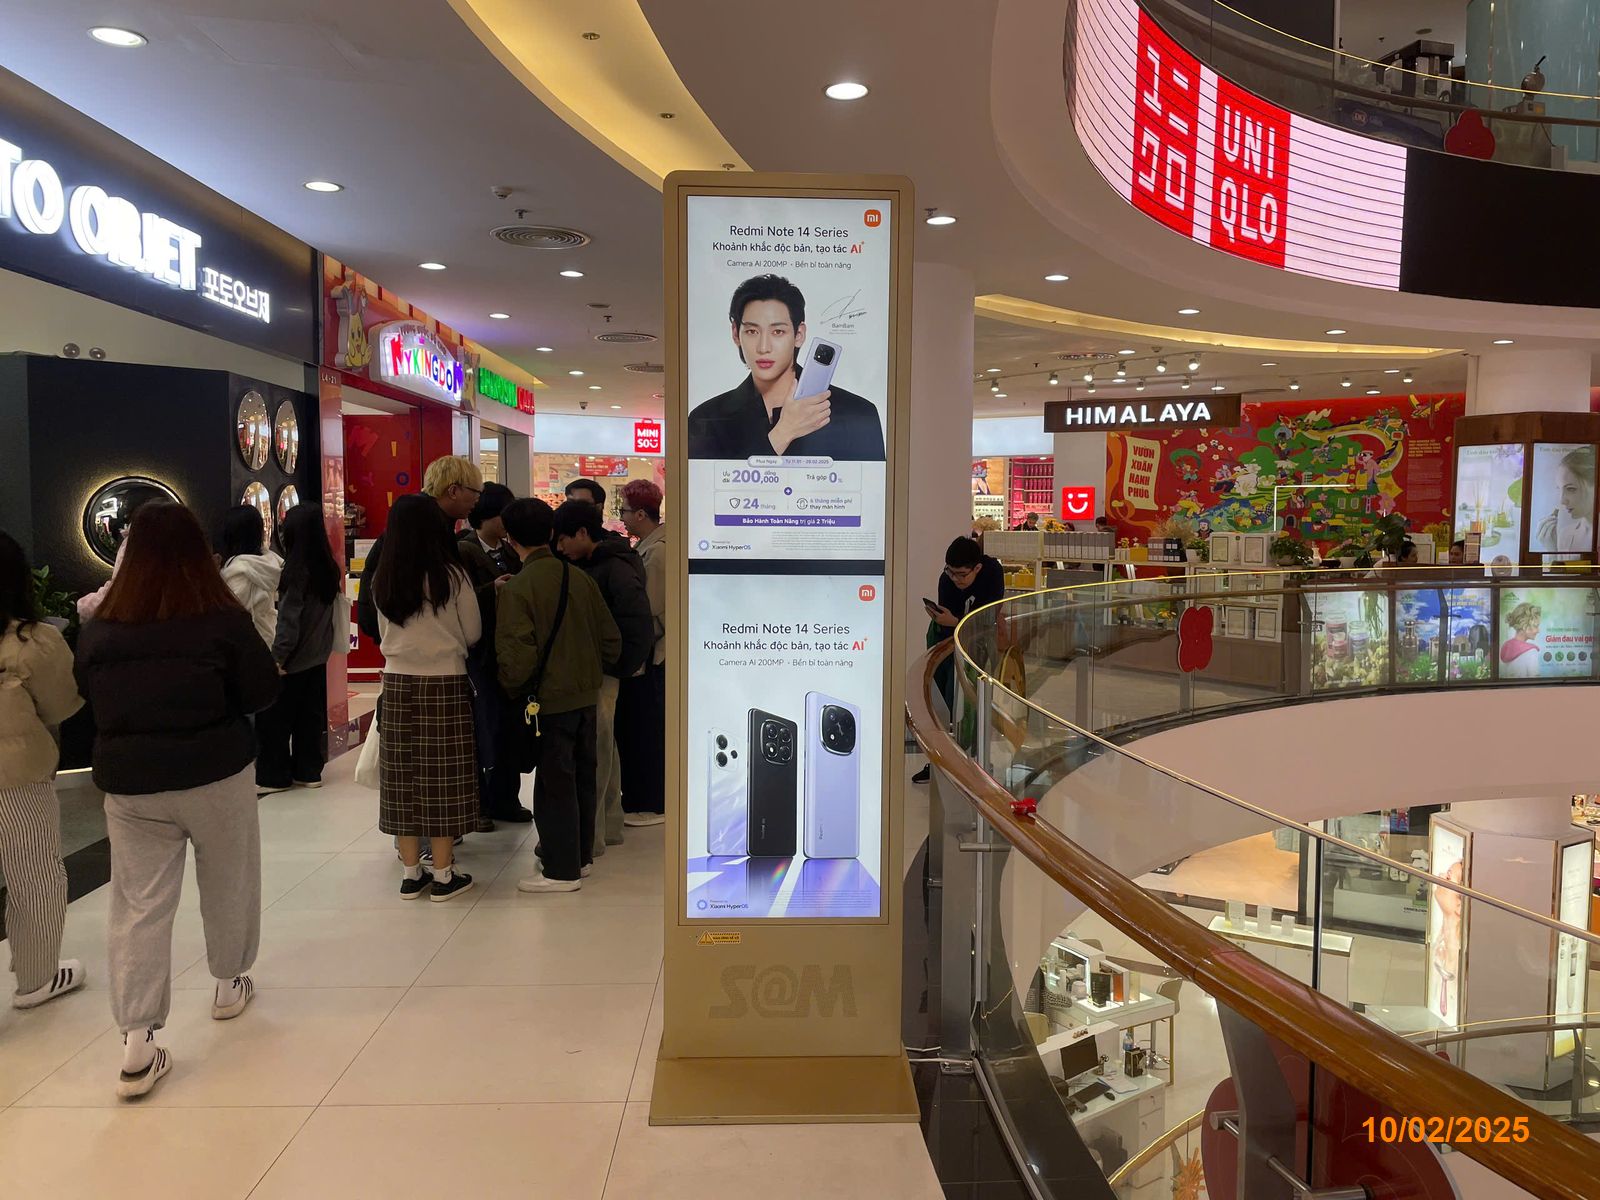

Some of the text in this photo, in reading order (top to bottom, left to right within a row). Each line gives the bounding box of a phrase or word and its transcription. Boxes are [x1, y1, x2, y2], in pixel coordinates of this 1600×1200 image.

[1223, 104, 1275, 180] UNI
[1219, 176, 1278, 244] QLO
[730, 225, 848, 238] Redmi Note 14 Series
[712, 241, 748, 252] Khoảnh
[750, 240, 771, 252] khắc
[774, 243, 790, 254] độc
[794, 243, 813, 254] bản,
[816, 245, 830, 255] tạo
[833, 244, 847, 254] tác
[834, 262, 852, 270] năng
[202, 267, 270, 324] 포토오브제
[390, 334, 464, 395] MYKINGDOM
[1066, 402, 1211, 426] HIMALAYA
[637, 428, 658, 438] MINI
[1128, 486, 1150, 499] PHÚC
[743, 498, 760, 509] 24
[722, 623, 850, 634] Redmi Note 14 Series
[704, 640, 741, 650] Khoảnh
[744, 638, 767, 650] khắc
[770, 641, 788, 652] độc
[792, 641, 812, 652] bản,
[815, 642, 830, 652] tạo
[833, 641, 848, 650] tác
[835, 660, 853, 668] năng
